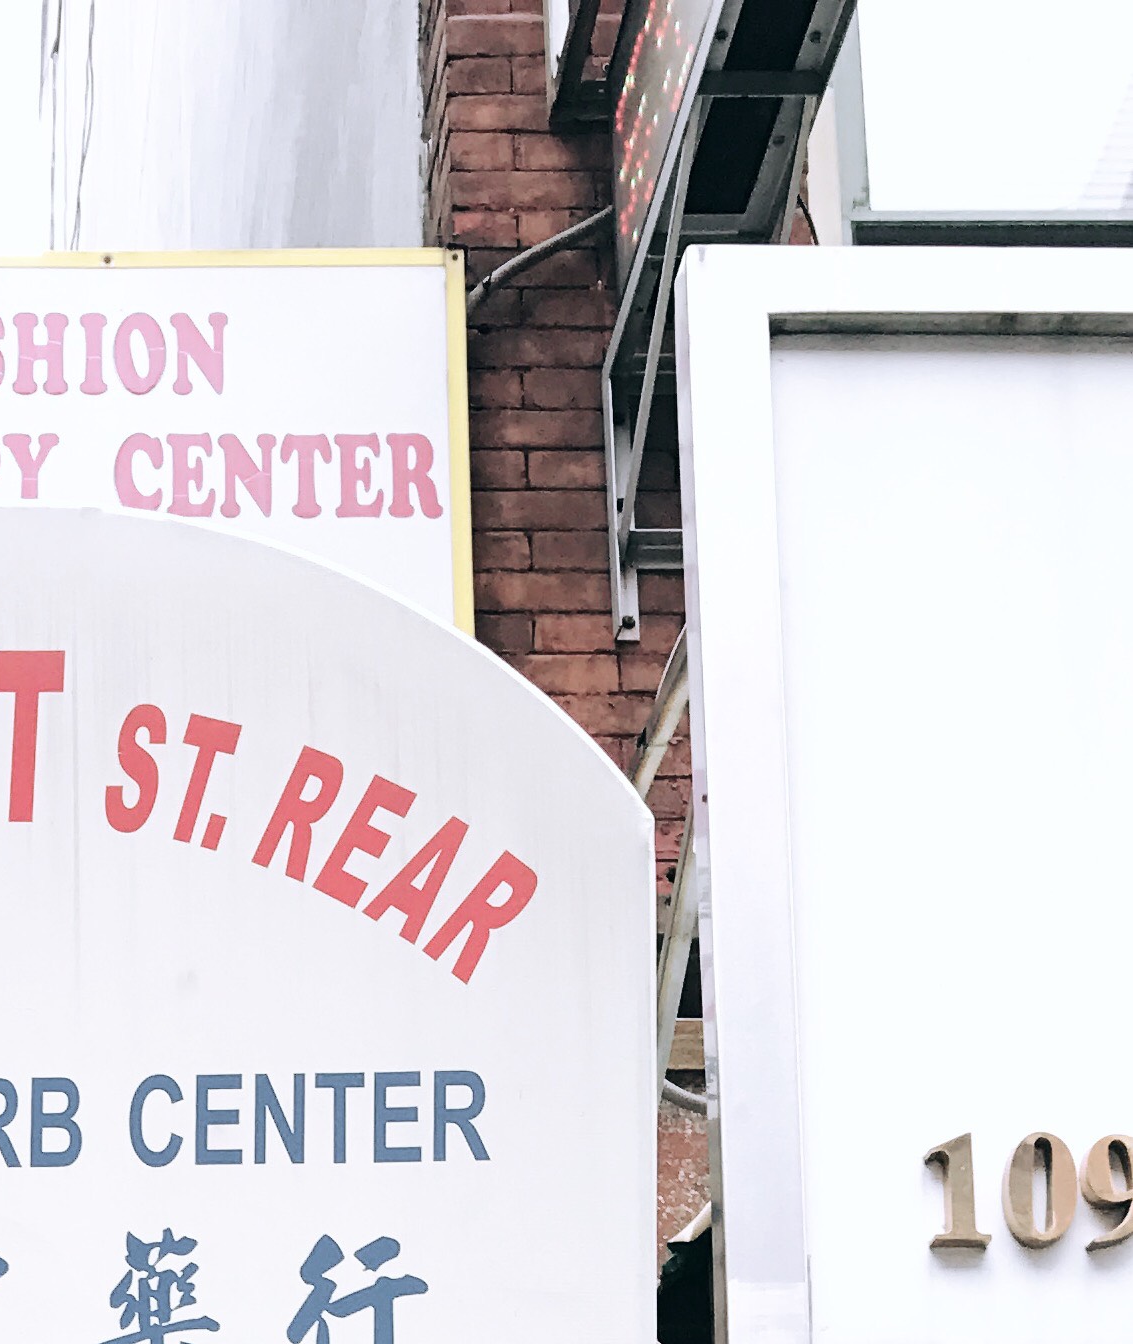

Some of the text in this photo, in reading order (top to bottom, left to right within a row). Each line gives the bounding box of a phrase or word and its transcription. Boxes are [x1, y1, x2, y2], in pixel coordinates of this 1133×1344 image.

[113, 432, 444, 521] CENTER
[104, 703, 243, 851] ST.
[251, 745, 538, 986] REAR
[128, 1070, 491, 1168] CENTER
[922, 1131, 1133, 1252] 109
